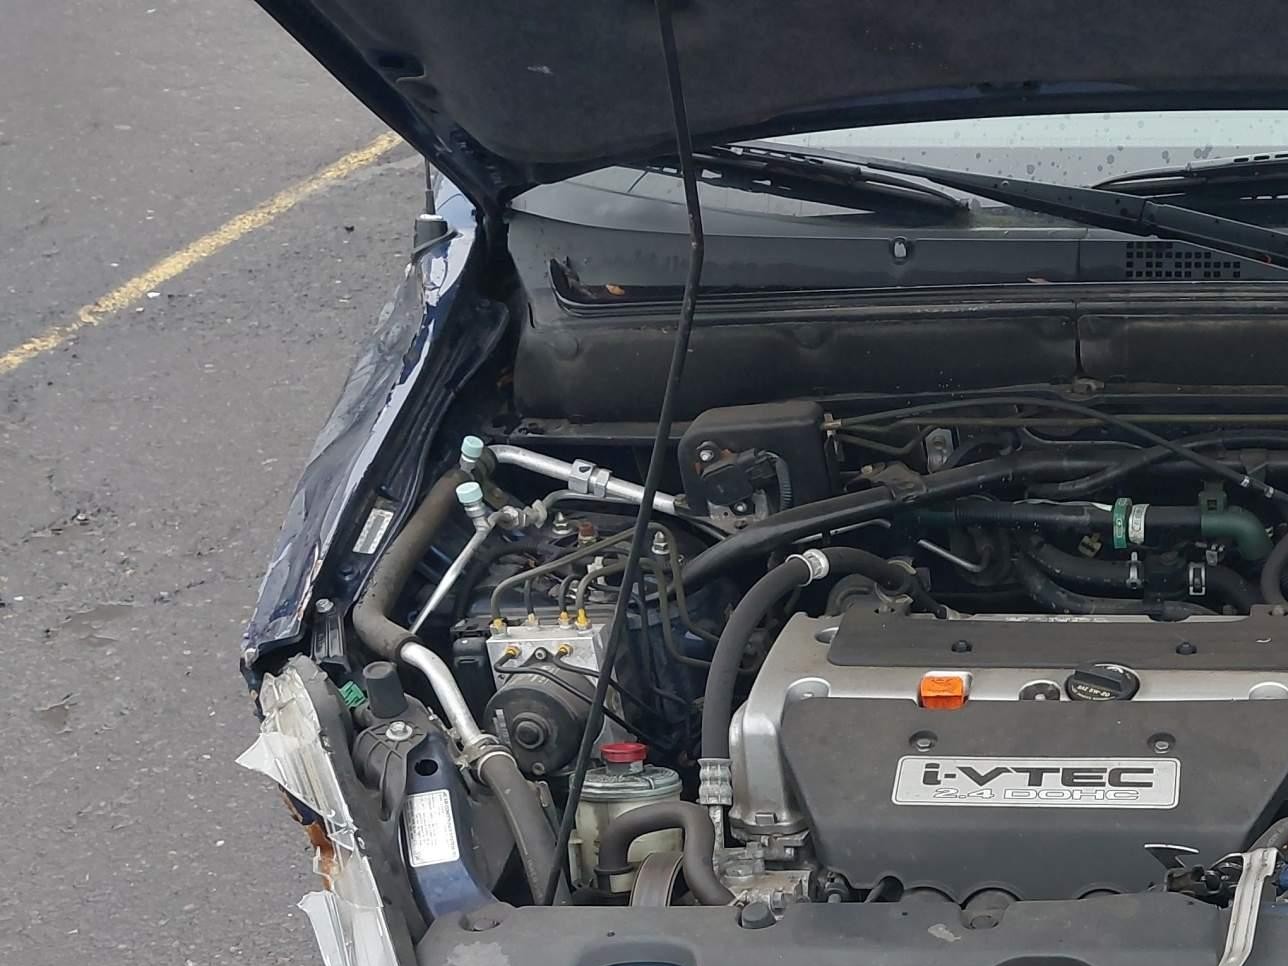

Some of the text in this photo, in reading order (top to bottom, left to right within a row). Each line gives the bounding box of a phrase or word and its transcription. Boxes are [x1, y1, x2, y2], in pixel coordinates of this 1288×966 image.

[921, 762, 1154, 788] i-VTEC
[933, 788, 1140, 800] 2.4 DOHC
